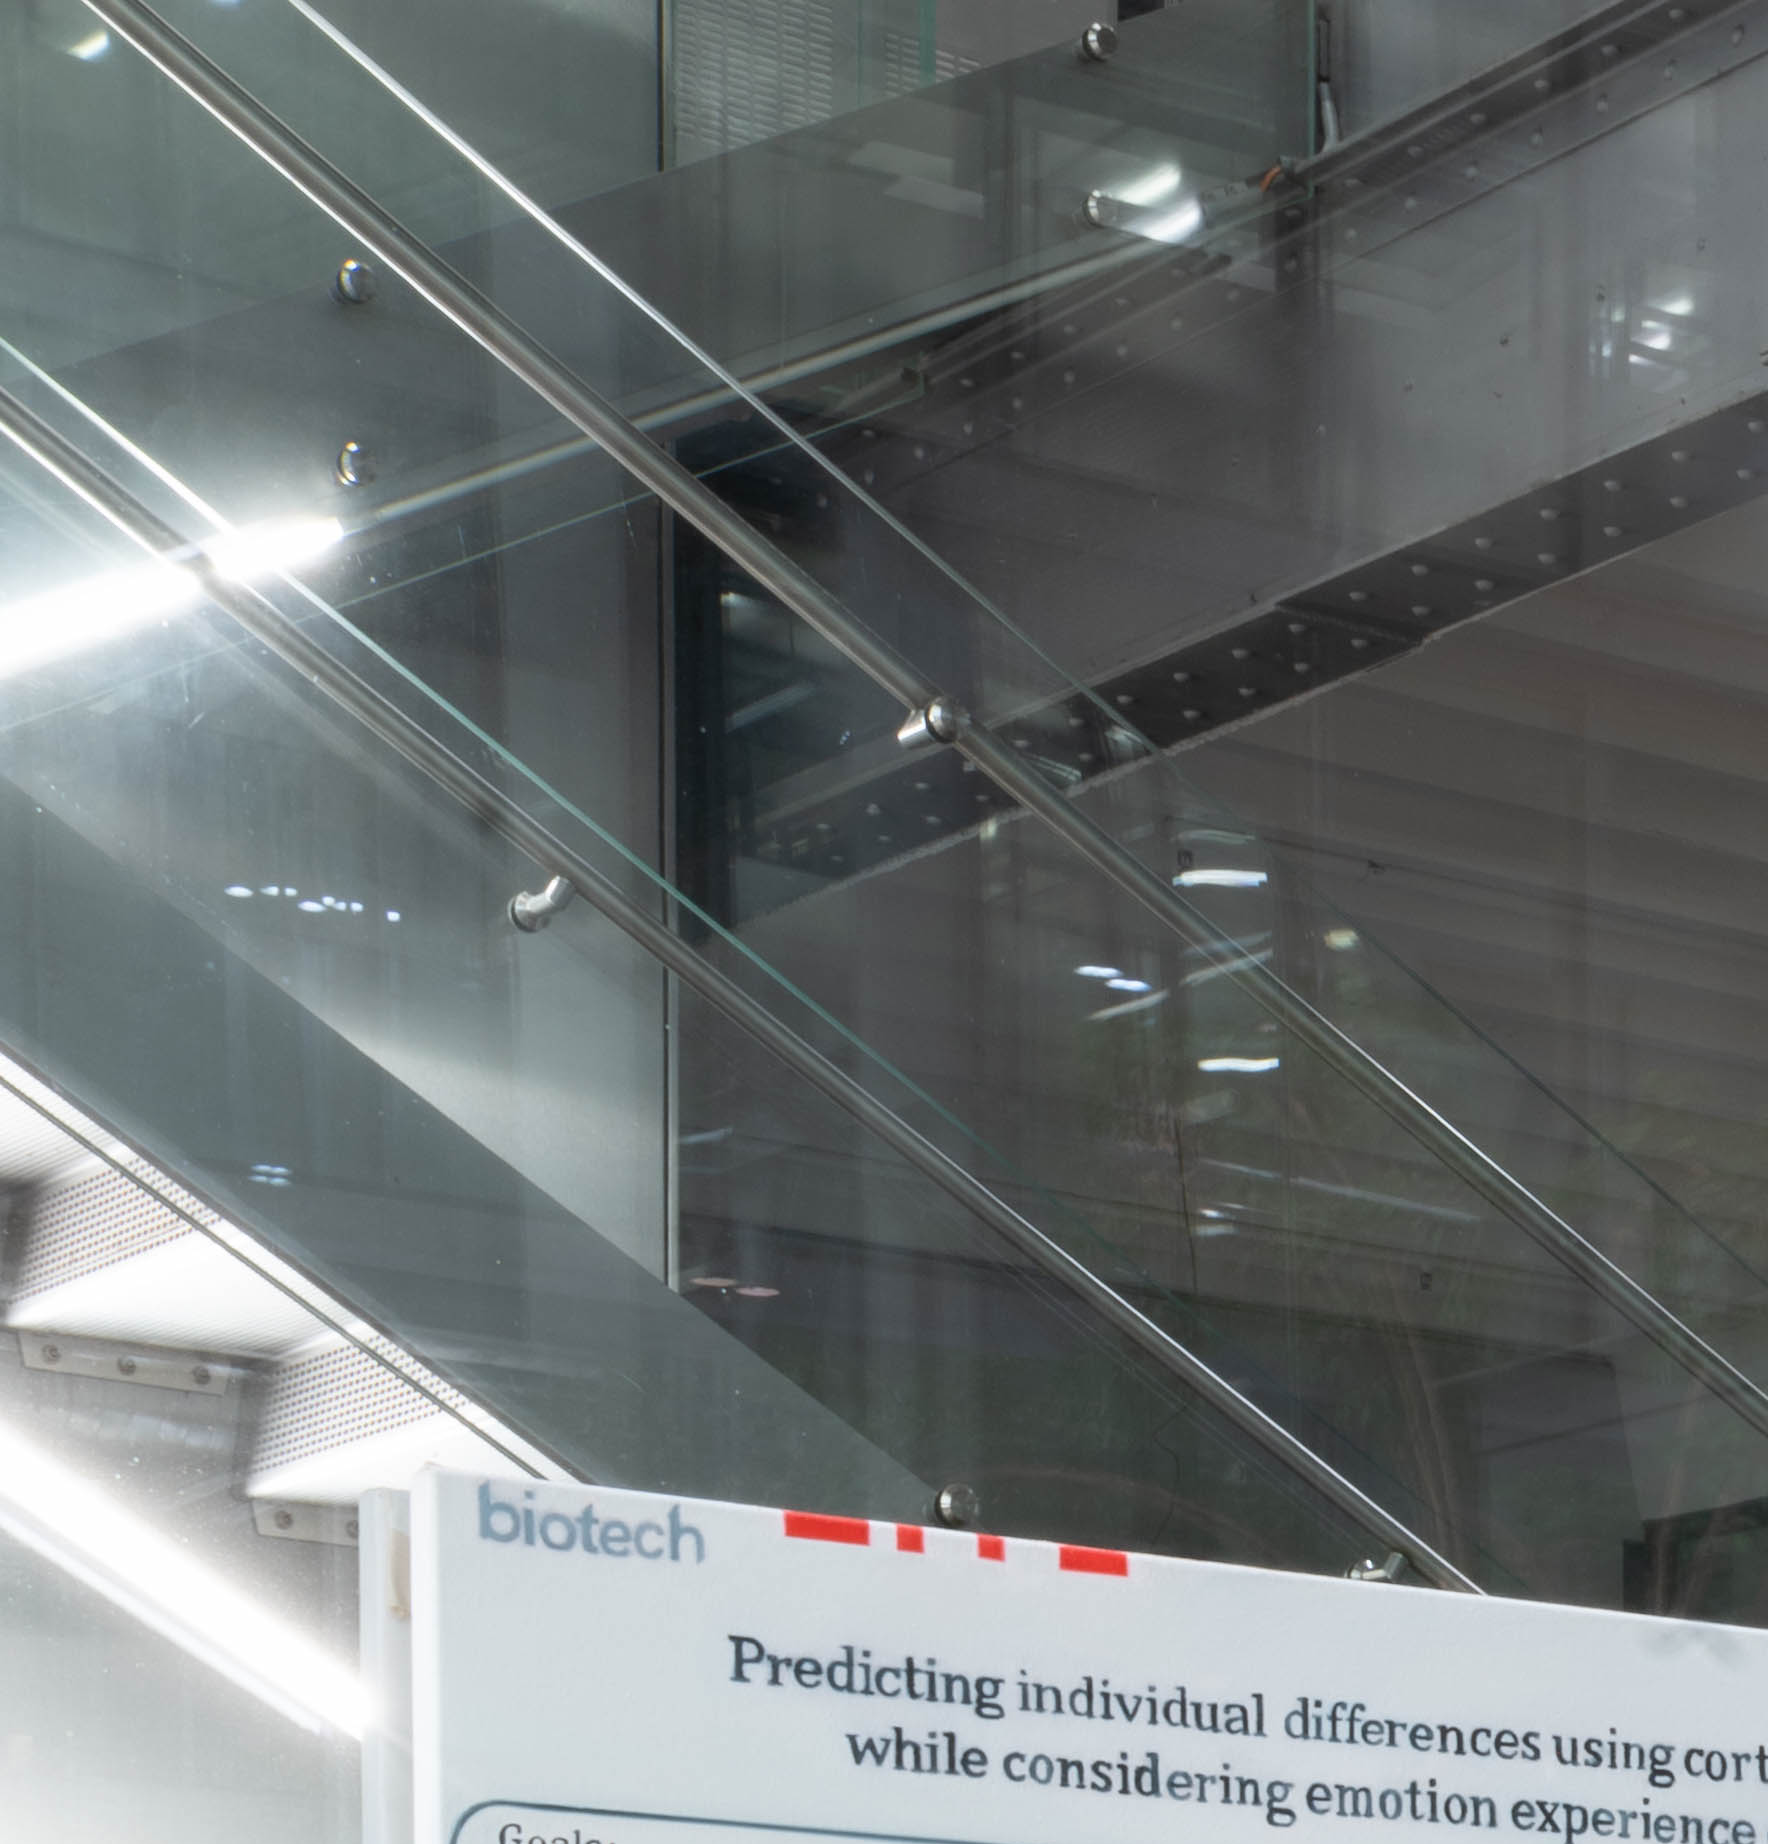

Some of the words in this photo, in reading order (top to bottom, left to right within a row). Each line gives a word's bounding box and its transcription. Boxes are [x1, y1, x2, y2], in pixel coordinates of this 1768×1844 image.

[478, 1482, 705, 1564] biotech
[727, 1634, 1006, 1720] Predicting
[1017, 1669, 1267, 1737] individual
[1284, 1696, 1541, 1762] differences
[1551, 1727, 1676, 1789] using
[845, 1726, 989, 1779] while
[1002, 1751, 1297, 1828] considering
[1305, 1778, 1498, 1829] emotion
